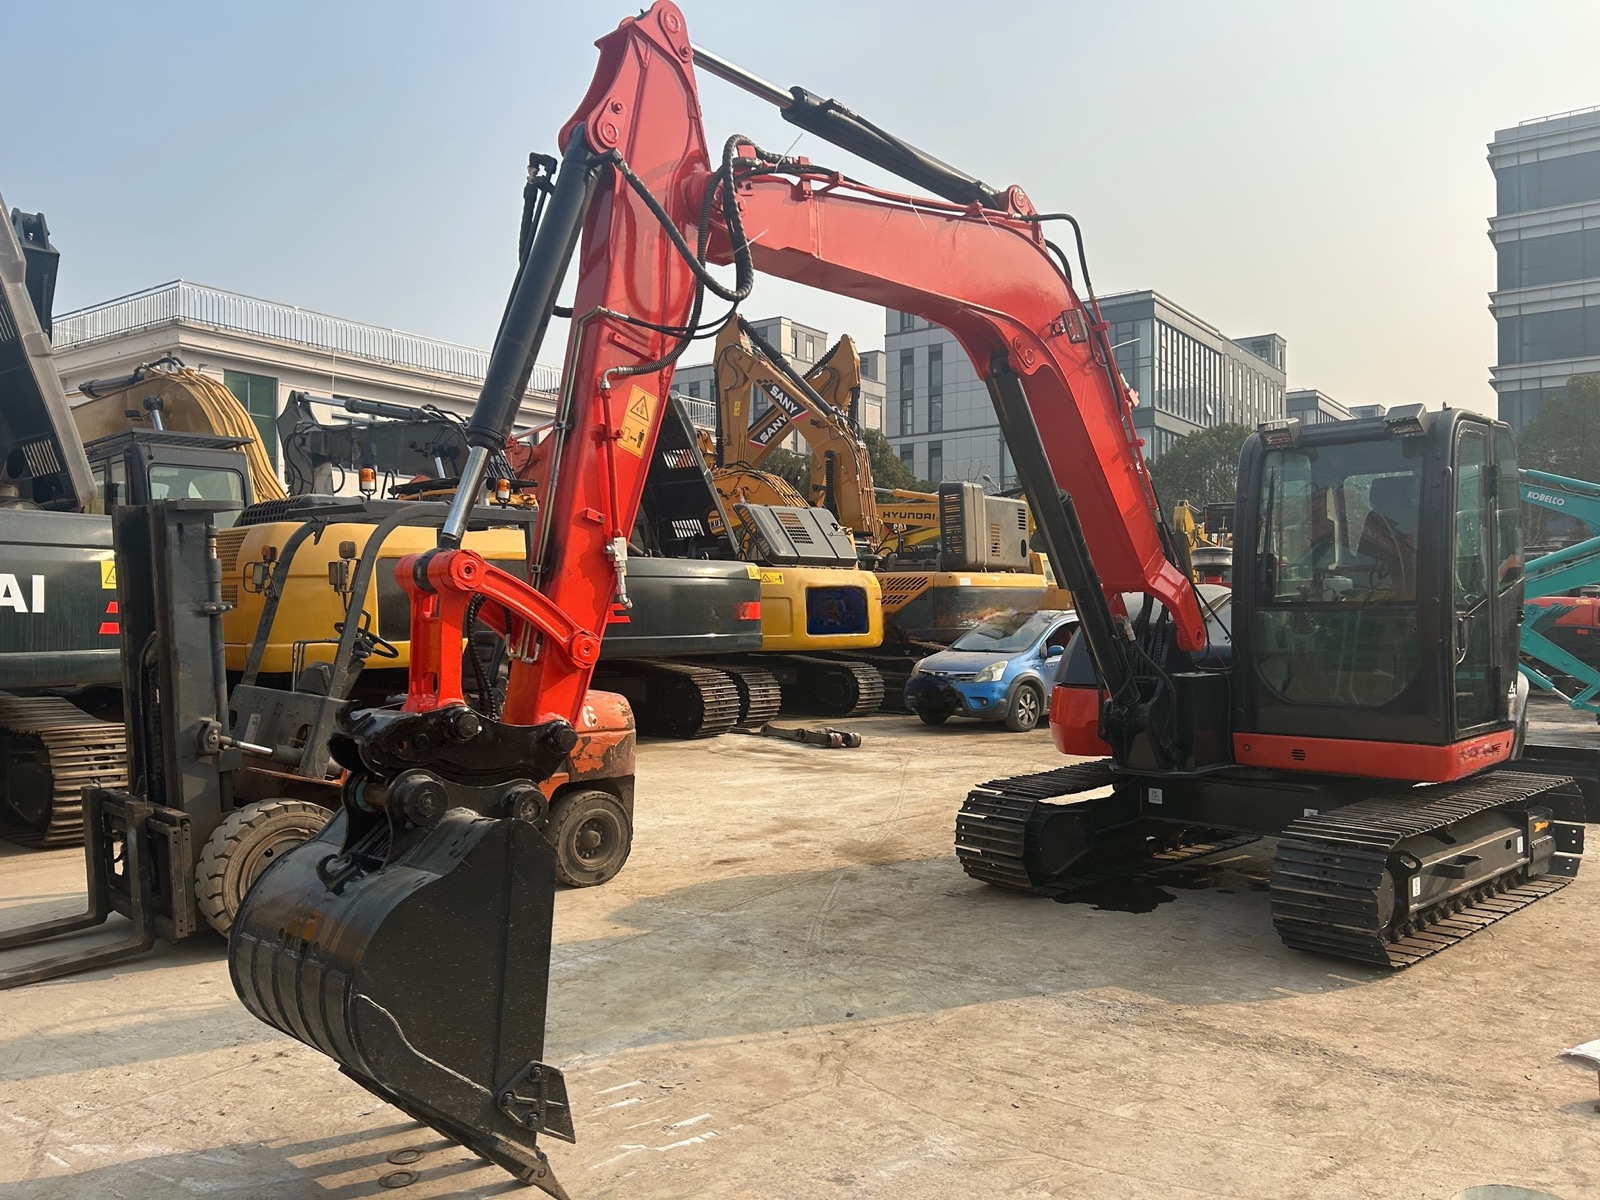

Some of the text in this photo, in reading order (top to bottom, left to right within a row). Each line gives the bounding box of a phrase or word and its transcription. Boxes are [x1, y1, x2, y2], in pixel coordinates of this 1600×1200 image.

[770, 385, 798, 414] SANY
[760, 414, 787, 443] SANY
[1527, 490, 1565, 506] KOBELCO
[883, 511, 936, 520] HYUNDAI
[582, 705, 599, 728] 6
